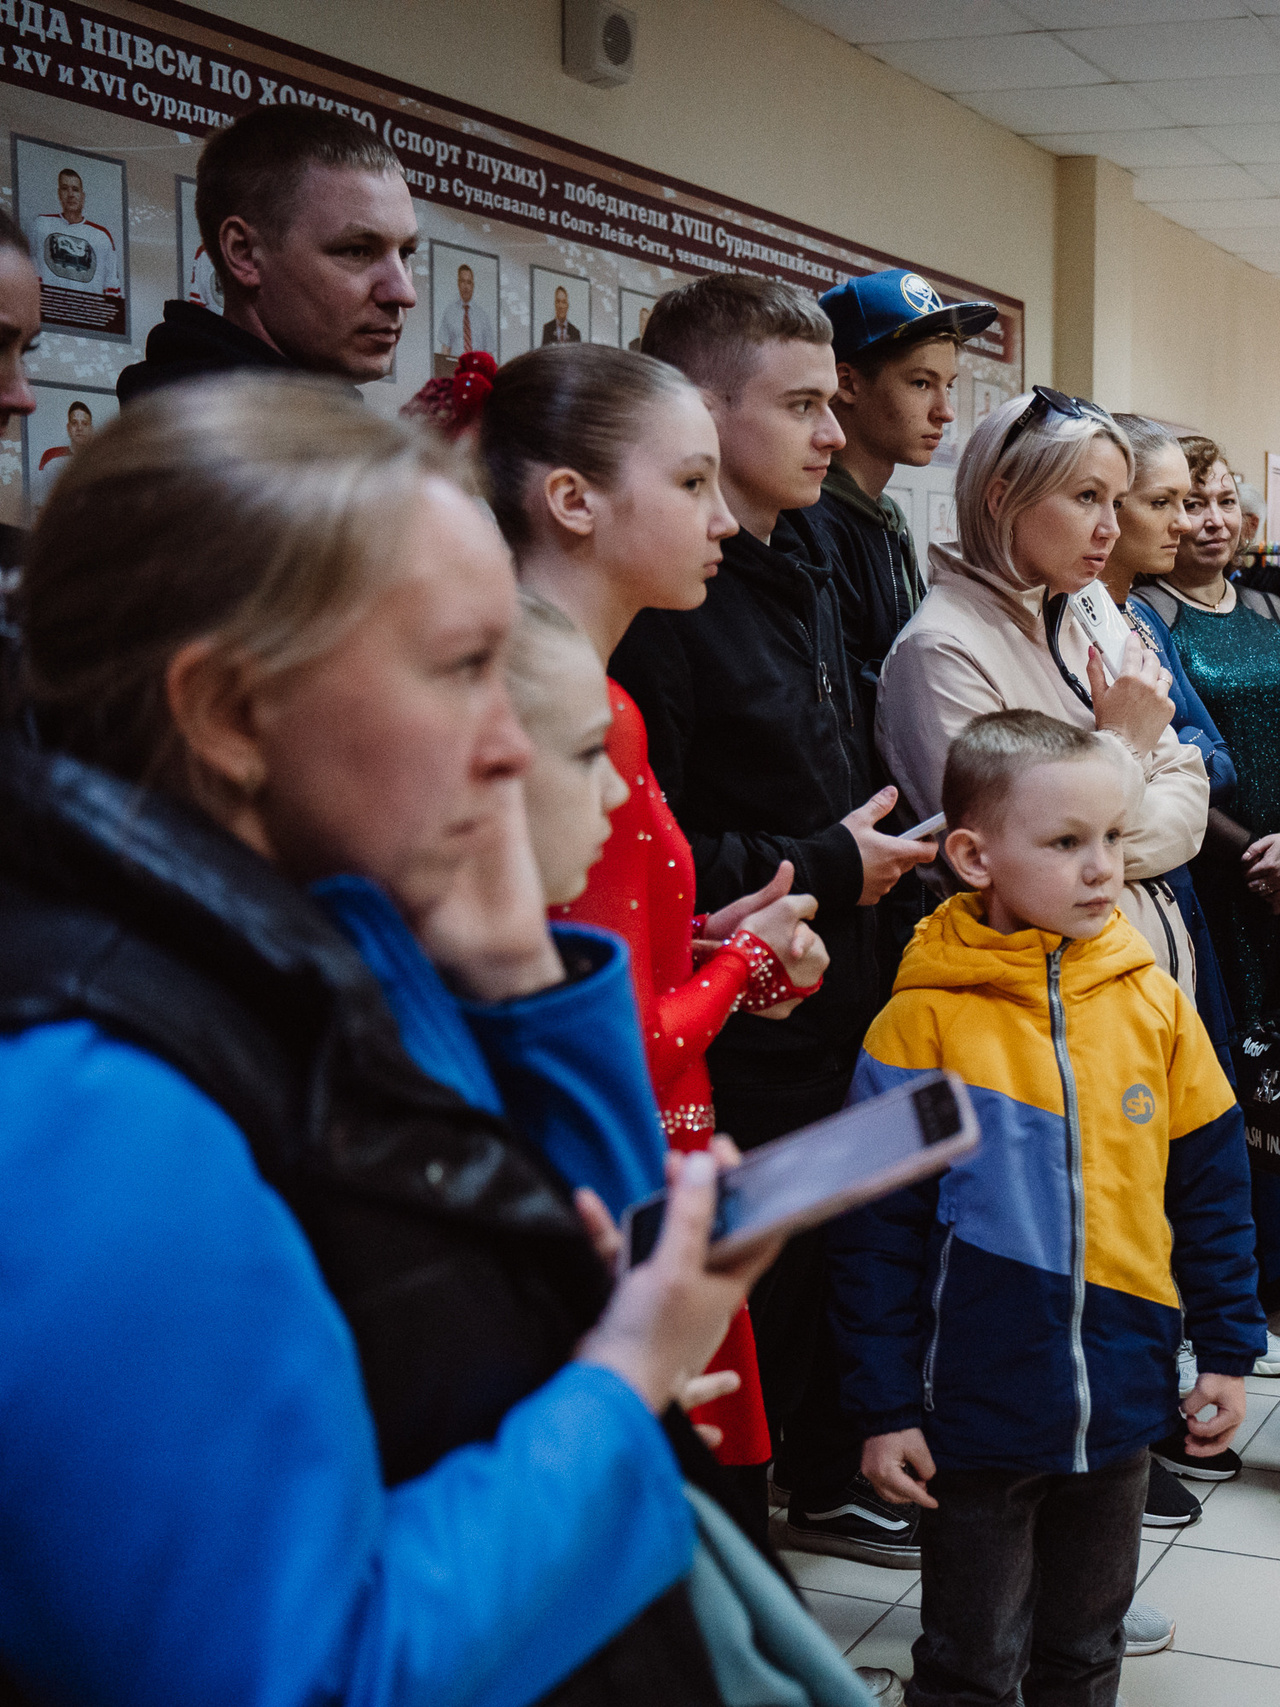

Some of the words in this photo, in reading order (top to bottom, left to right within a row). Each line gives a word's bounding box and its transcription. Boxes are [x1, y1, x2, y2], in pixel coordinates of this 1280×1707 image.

[12, 44, 52, 78] XV
[58, 63, 75, 86] и
[80, 65, 127, 101] XVI
[405, 167, 436, 194] игр
[439, 177, 450, 193] в
[452, 177, 547, 222] Сундсвалле
[548, 210, 558, 226] и
[80, 17, 202, 86] НЦВСМ
[209, 60, 252, 100] ПО
[383, 118, 461, 167] (спорт
[466, 149, 547, 199] глухих)
[563, 181, 669, 231] победители
